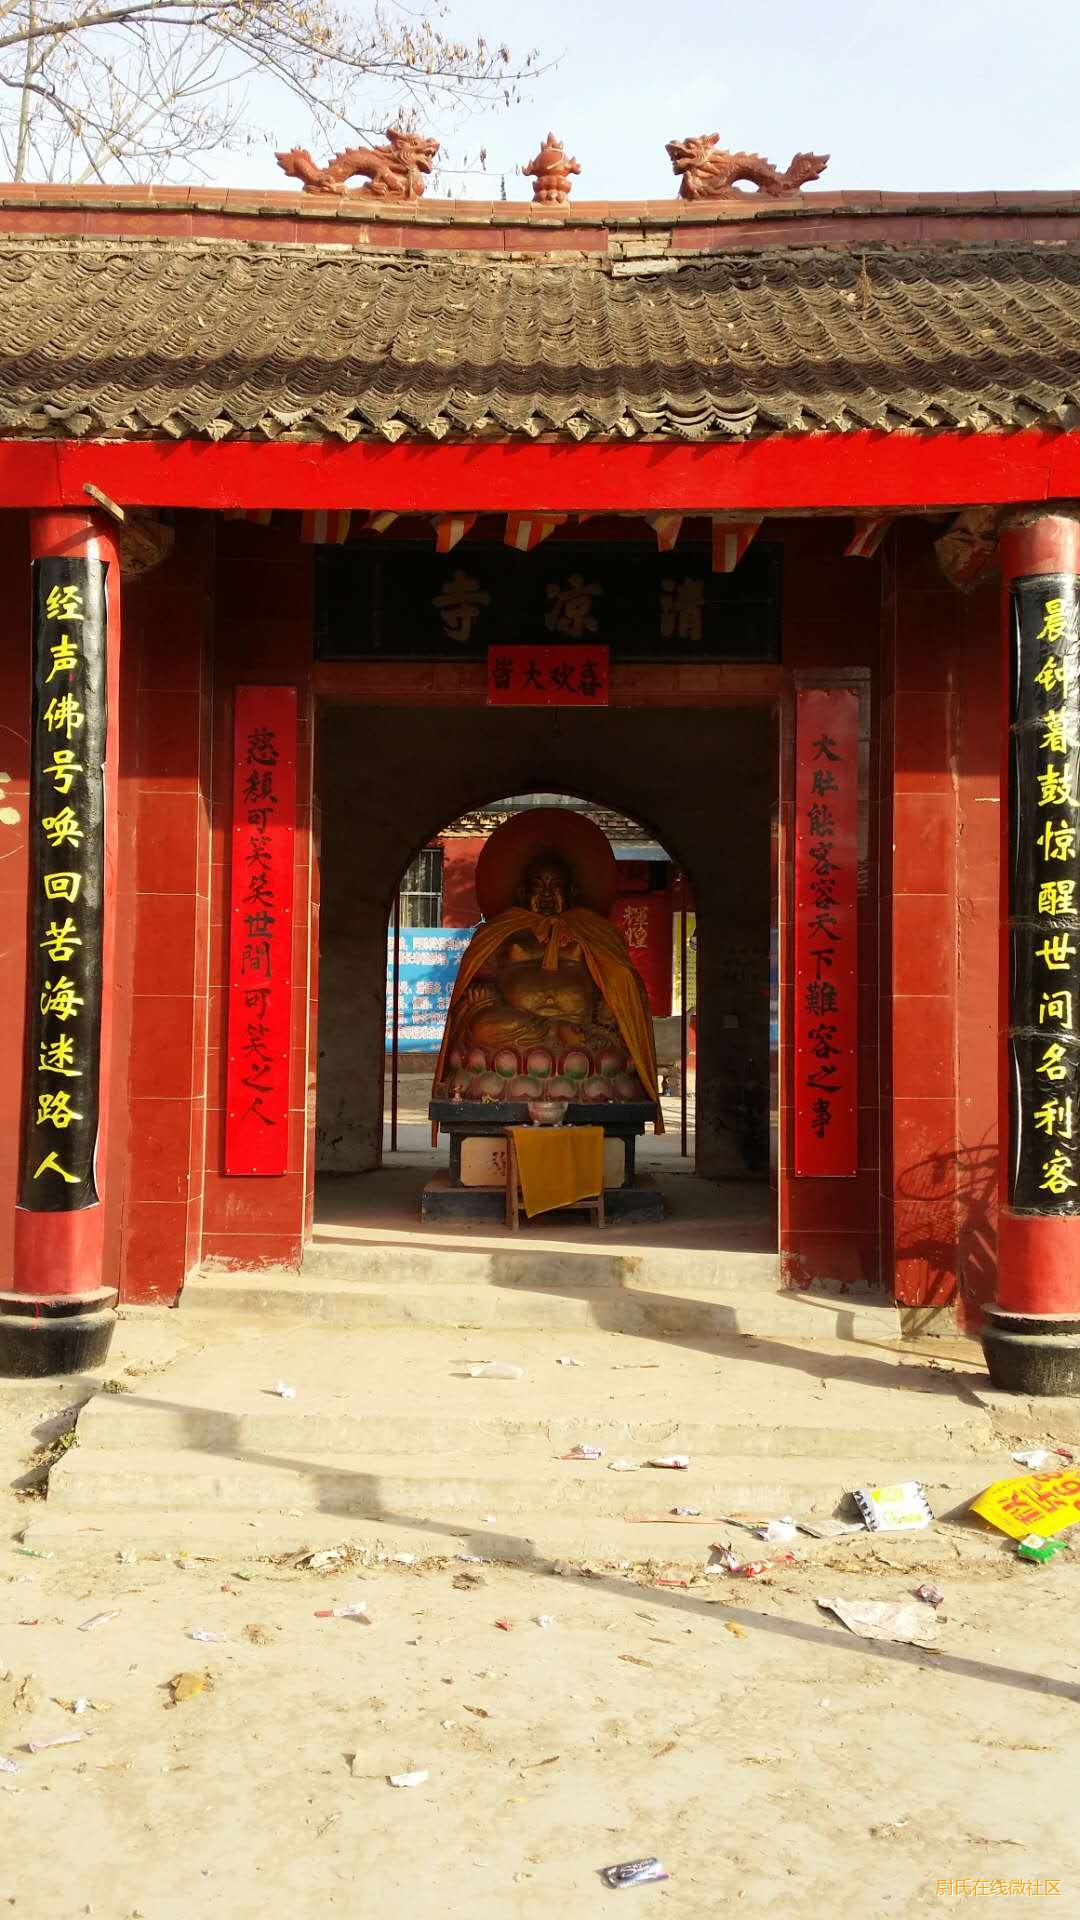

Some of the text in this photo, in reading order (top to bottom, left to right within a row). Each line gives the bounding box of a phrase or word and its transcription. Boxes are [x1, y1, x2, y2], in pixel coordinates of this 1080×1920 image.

[34, 585, 85, 1184] 经声佛号唤回苦海迷路人
[1034, 598, 1080, 1194] 晨钟暮鼓惊醒世间名利客
